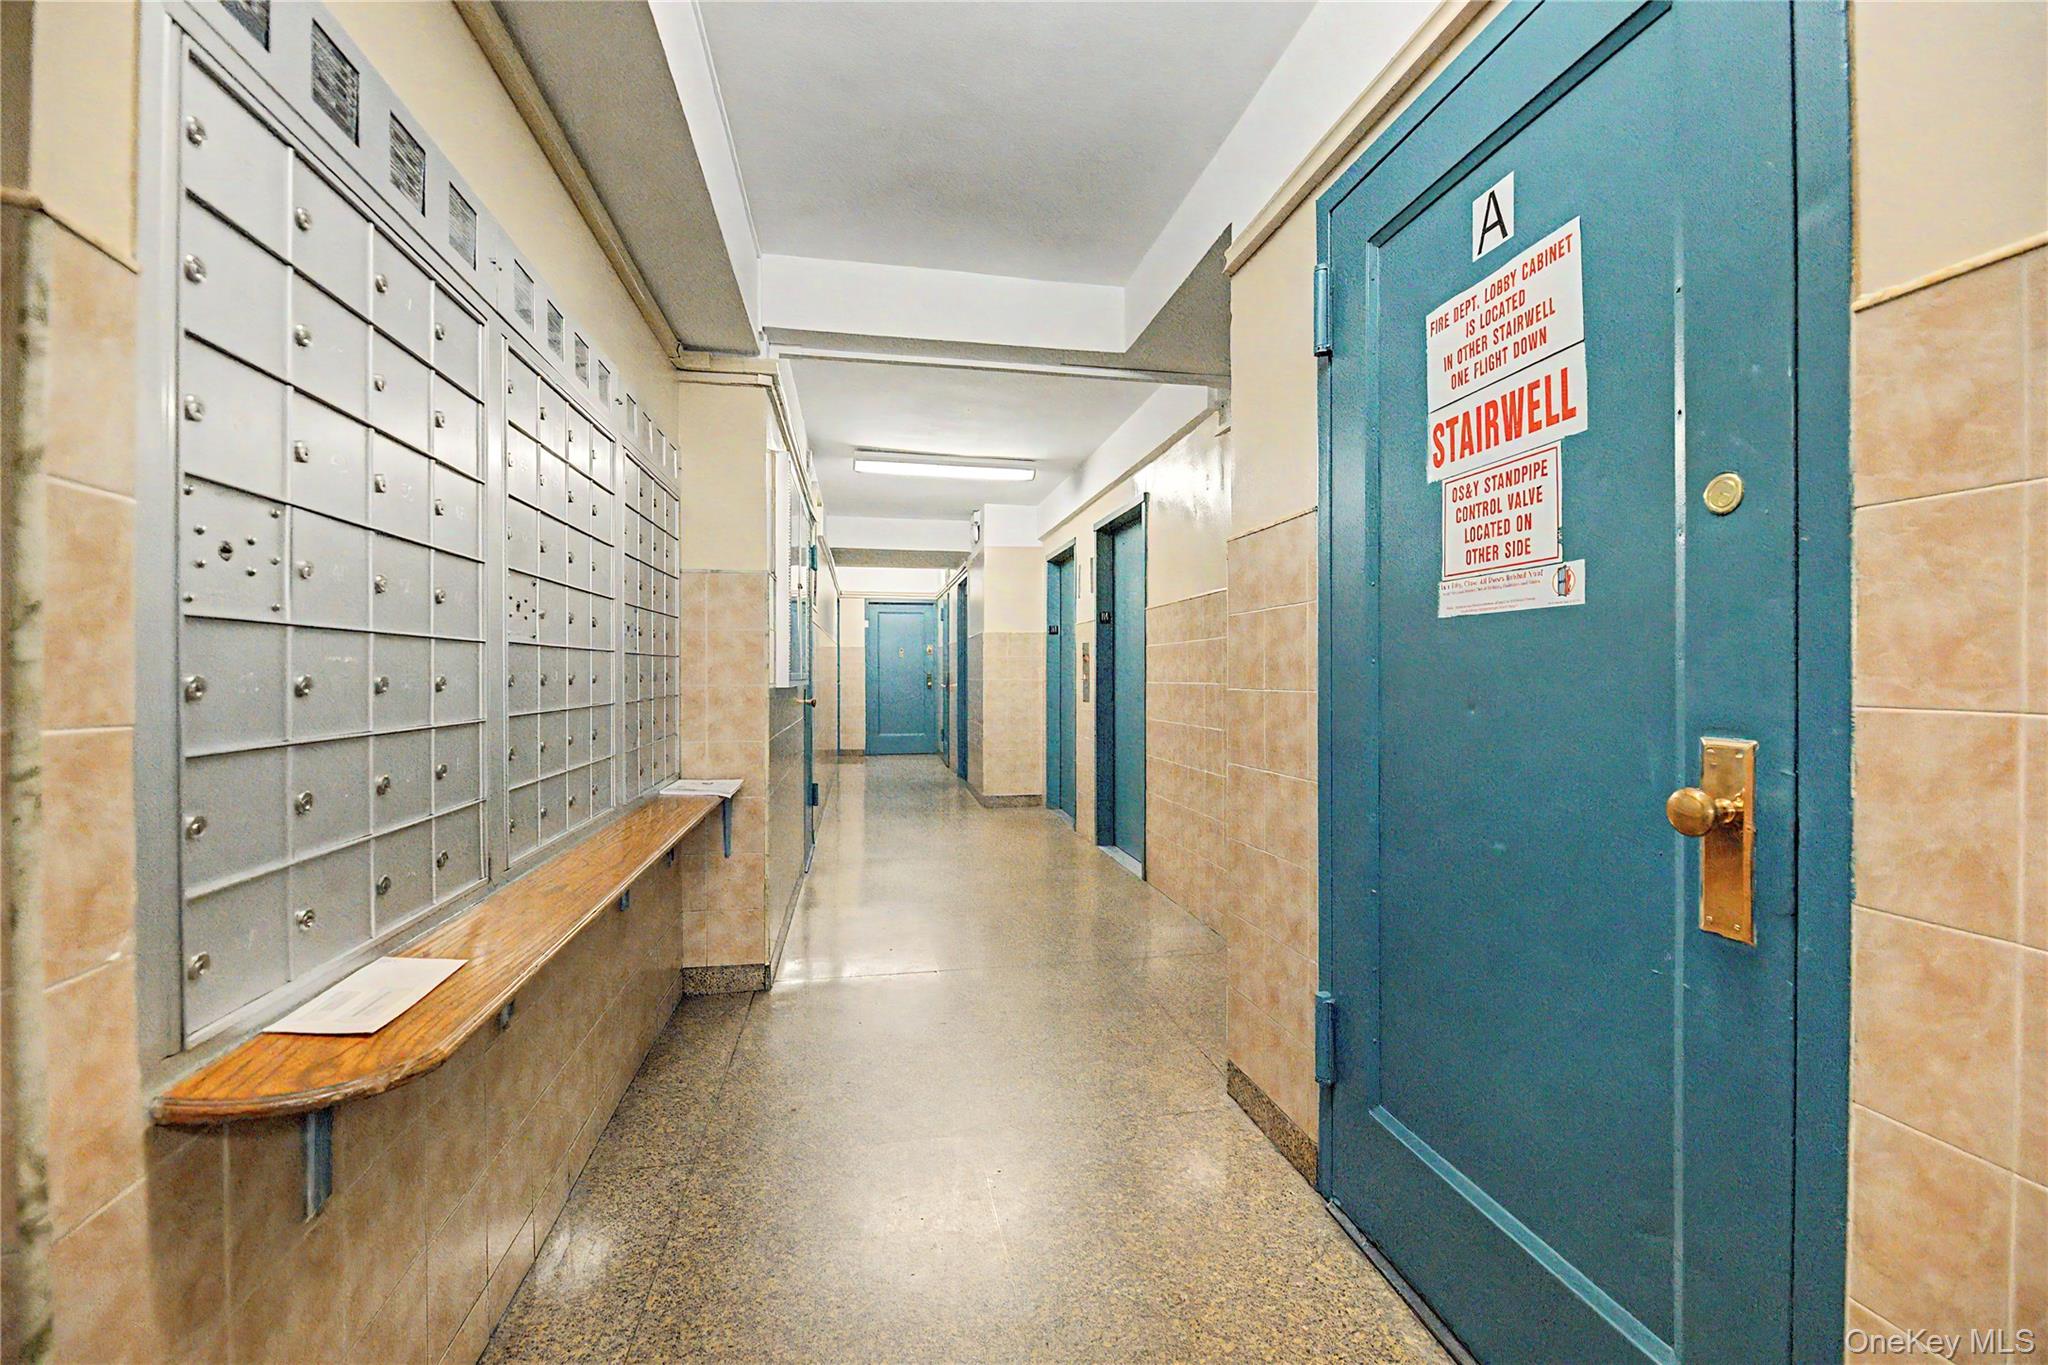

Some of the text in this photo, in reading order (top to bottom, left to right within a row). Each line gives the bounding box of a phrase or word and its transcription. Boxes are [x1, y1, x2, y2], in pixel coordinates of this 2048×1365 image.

[1477, 190, 1508, 256] A
[1430, 233, 1573, 338] FIRE DEPT. LOBBY CABINET
[1466, 289, 1526, 338] IS LOCATED
[1443, 297, 1556, 372] IN OTHER STAIRWELL
[1451, 326, 1548, 390] ONE FLIGHT DOWN
[1432, 367, 1577, 469] STAIRWELL
[1452, 458, 1549, 503] OS&Y STANDPIPE
[1455, 485, 1544, 524] CONTROL VALVE
[1464, 512, 1532, 544] LOCATED ON
[1465, 537, 1532, 566] OTHER SIDE
